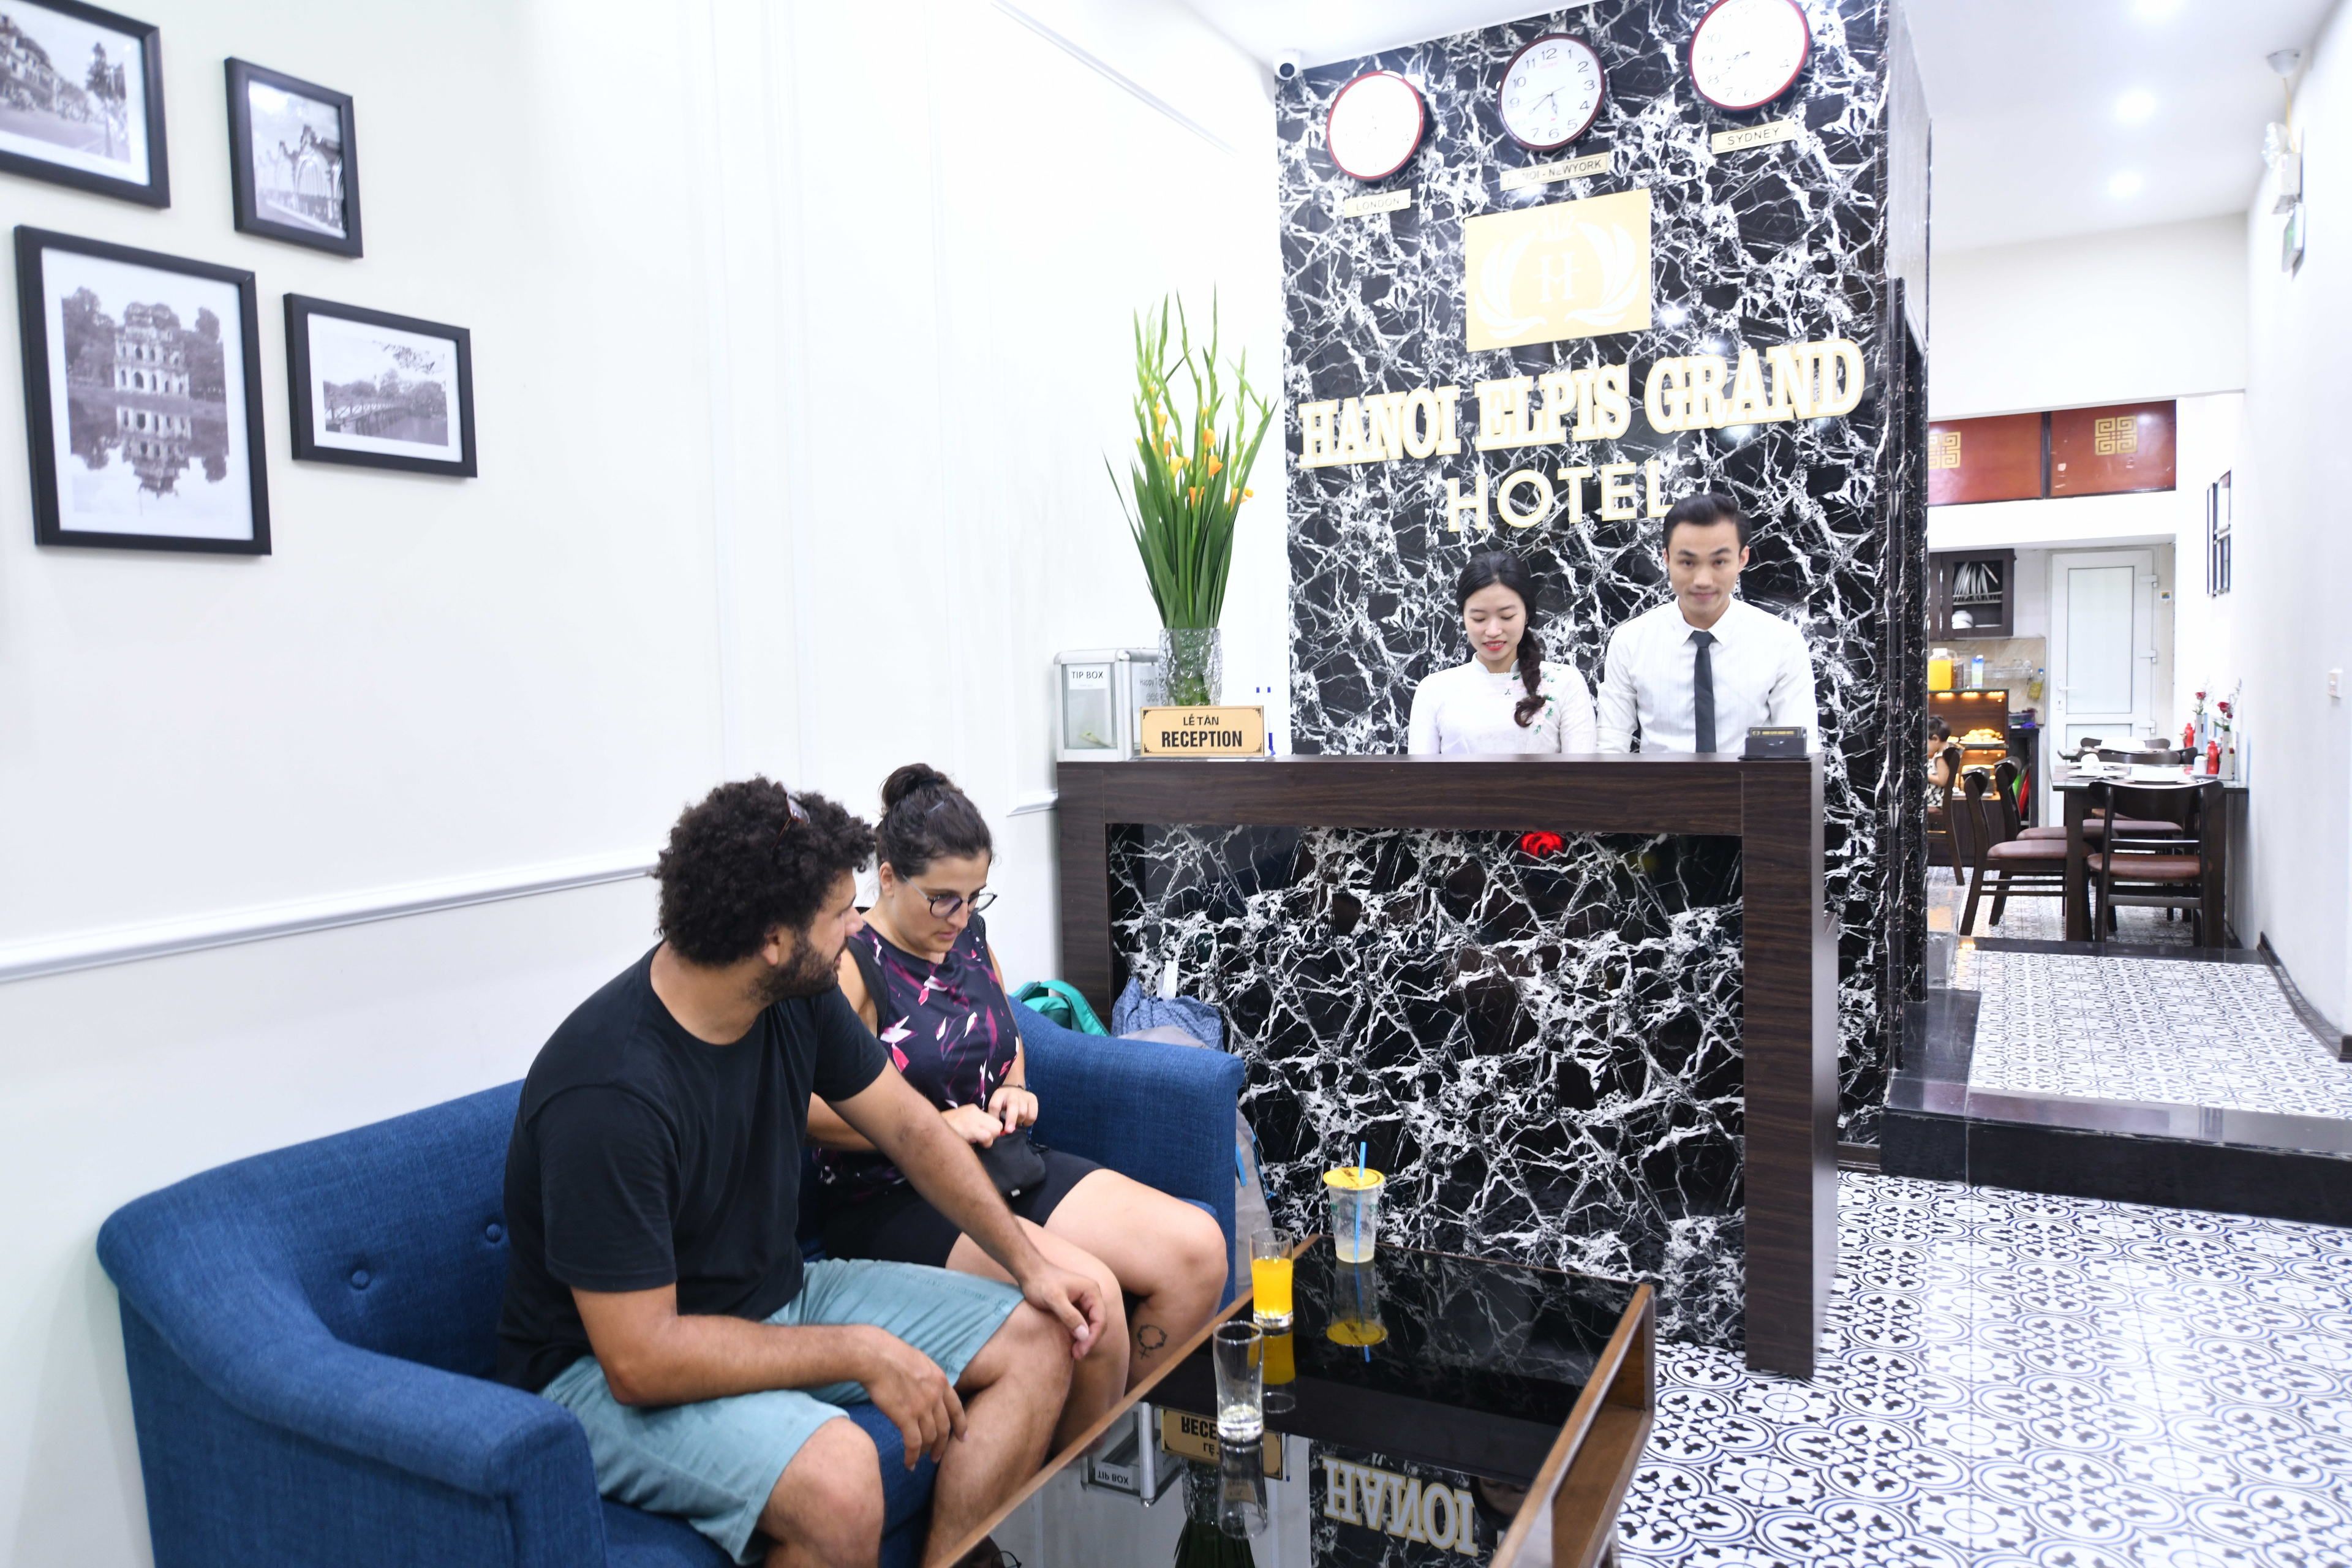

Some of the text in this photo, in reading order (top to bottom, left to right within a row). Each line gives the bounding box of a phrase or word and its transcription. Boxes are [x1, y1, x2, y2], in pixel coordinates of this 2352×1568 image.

[1541, 48, 1558, 61] 12
[1526, 58, 1536, 69] 11
[1577, 61, 1589, 73] 2
[1513, 77, 1526, 88] 10
[1584, 80, 1595, 91] 3
[1509, 97, 1520, 108] 9
[1580, 100, 1590, 110] 4
[1567, 118, 1578, 130] 5
[1531, 127, 1539, 138] 7
[1548, 128, 1559, 139] 6
[1727, 127, 1779, 146] SYDNEY
[1356, 198, 1400, 211] LONDON
[1298, 338, 1865, 469] HANOI ELPIS GRAND
[1447, 460, 1674, 532] HOTEL
[1071, 671, 1104, 679] TIP BOX
[1196, 715, 1219, 726] TÂN
[1161, 730, 1242, 747] RECEPTION
